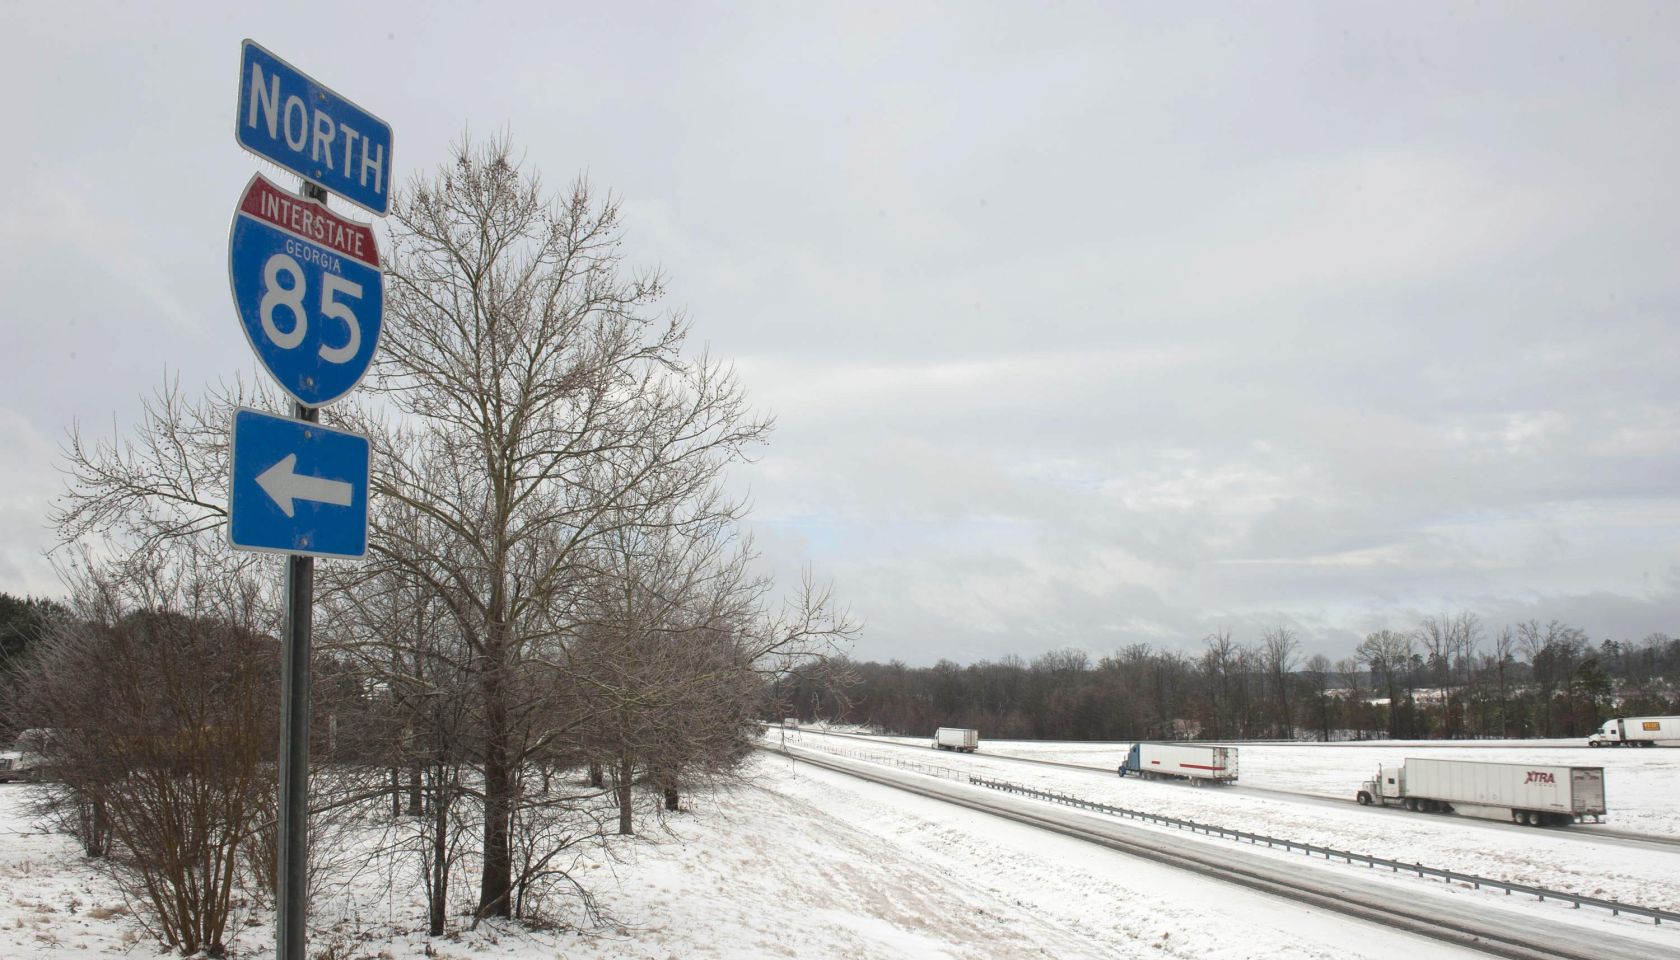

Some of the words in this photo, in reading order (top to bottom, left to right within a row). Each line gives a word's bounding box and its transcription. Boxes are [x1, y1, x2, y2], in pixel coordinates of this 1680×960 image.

[249, 62, 383, 194] NORTH
[261, 190, 364, 257] INTERSTATE
[286, 239, 341, 273] GEORGIA
[260, 253, 363, 364] 85
[1524, 770, 1556, 784] XTRA
